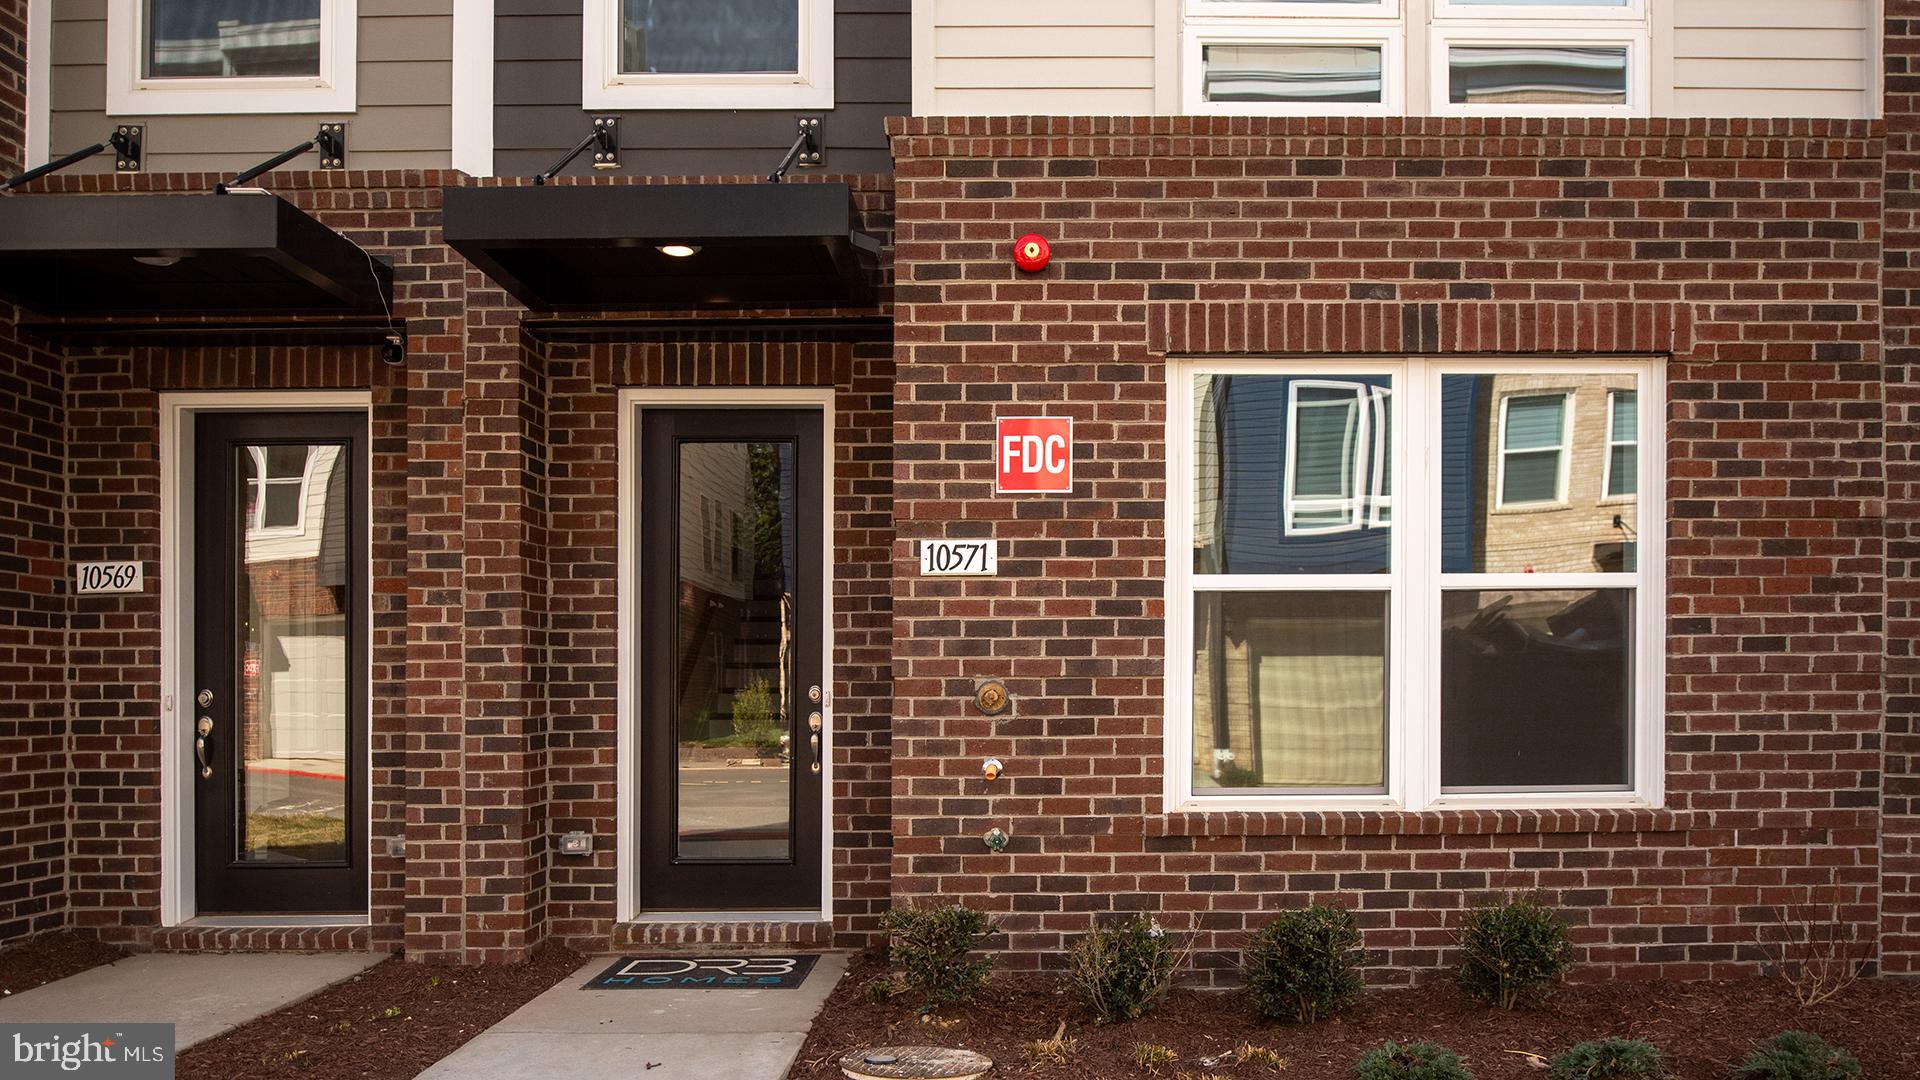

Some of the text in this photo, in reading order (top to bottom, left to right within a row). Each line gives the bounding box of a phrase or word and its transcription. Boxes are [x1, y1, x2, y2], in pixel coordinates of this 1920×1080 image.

[1002, 434, 1066, 474] FDC
[926, 543, 988, 572] 10571
[81, 565, 136, 590] 10569
[603, 976, 782, 984] HOMES
